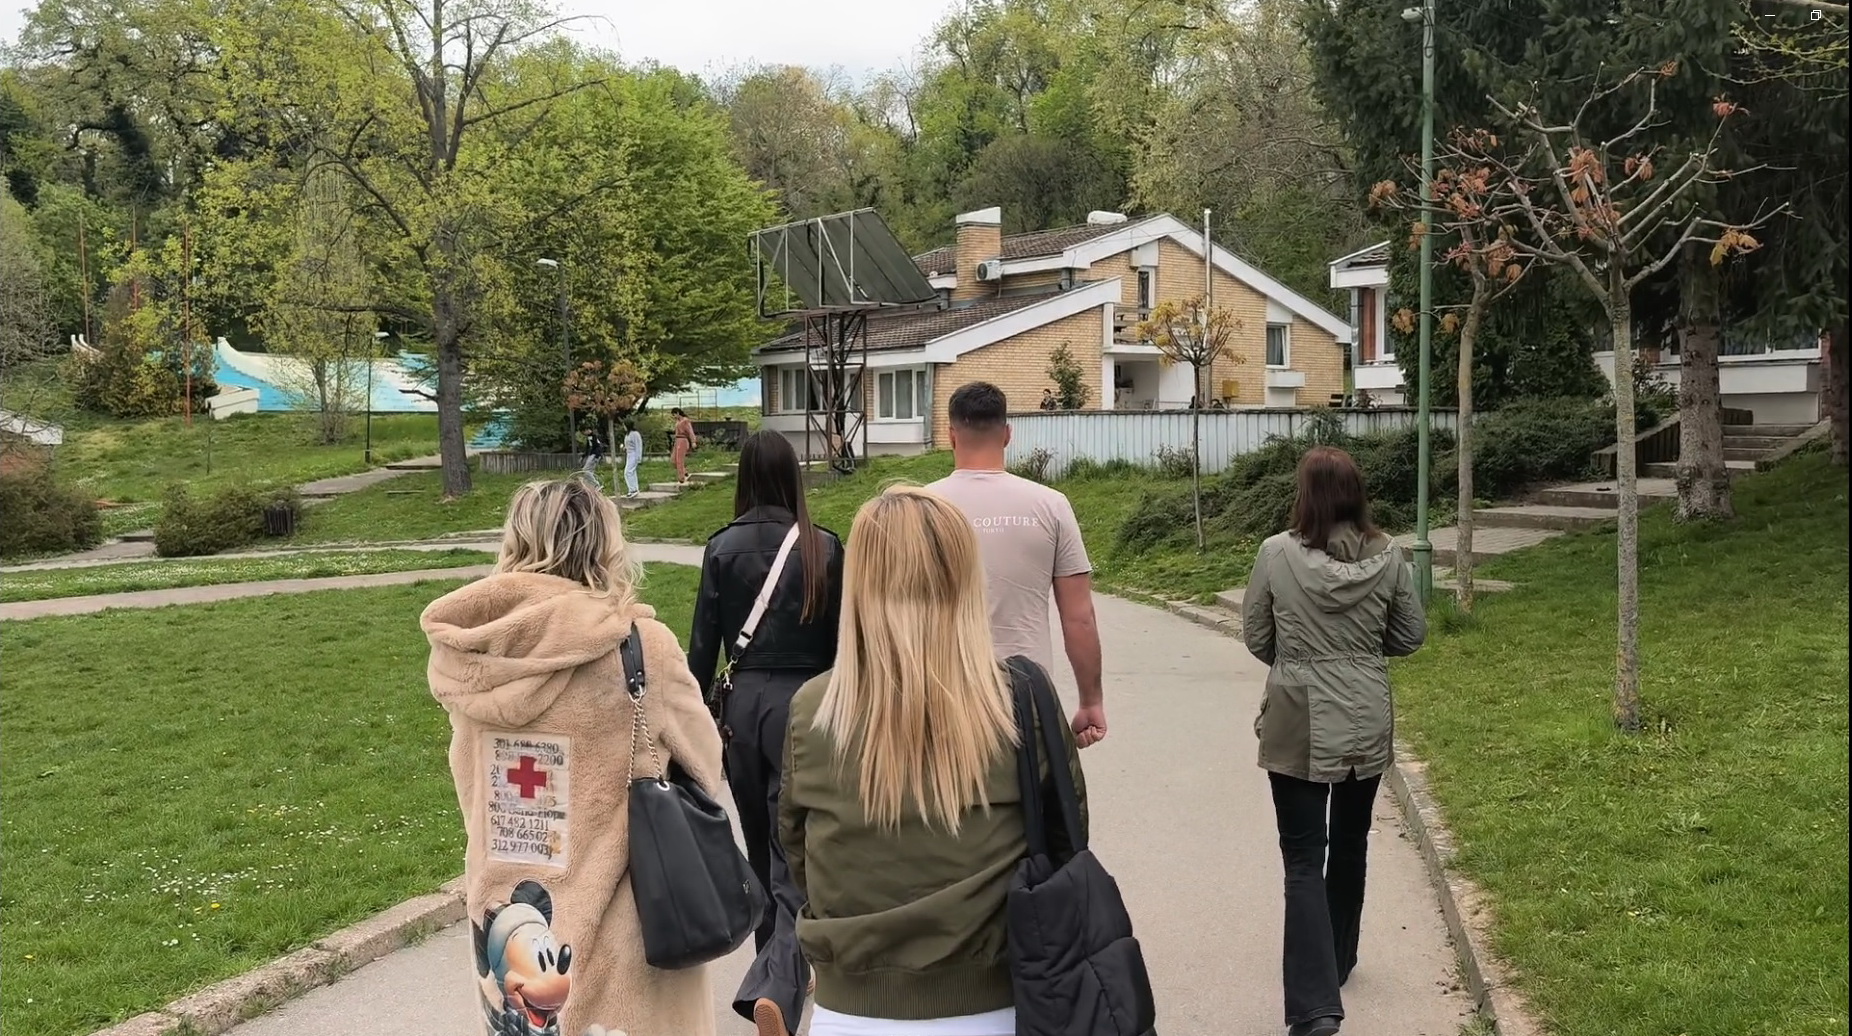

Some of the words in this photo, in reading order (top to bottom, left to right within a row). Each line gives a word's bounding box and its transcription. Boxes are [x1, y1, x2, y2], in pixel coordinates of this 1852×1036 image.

[973, 516, 1039, 528] COUTURE
[490, 814, 506, 826] 617
[507, 816, 526, 829] 482
[496, 825, 514, 838] 708
[491, 838, 509, 851] 312
[510, 841, 529, 853] 977
